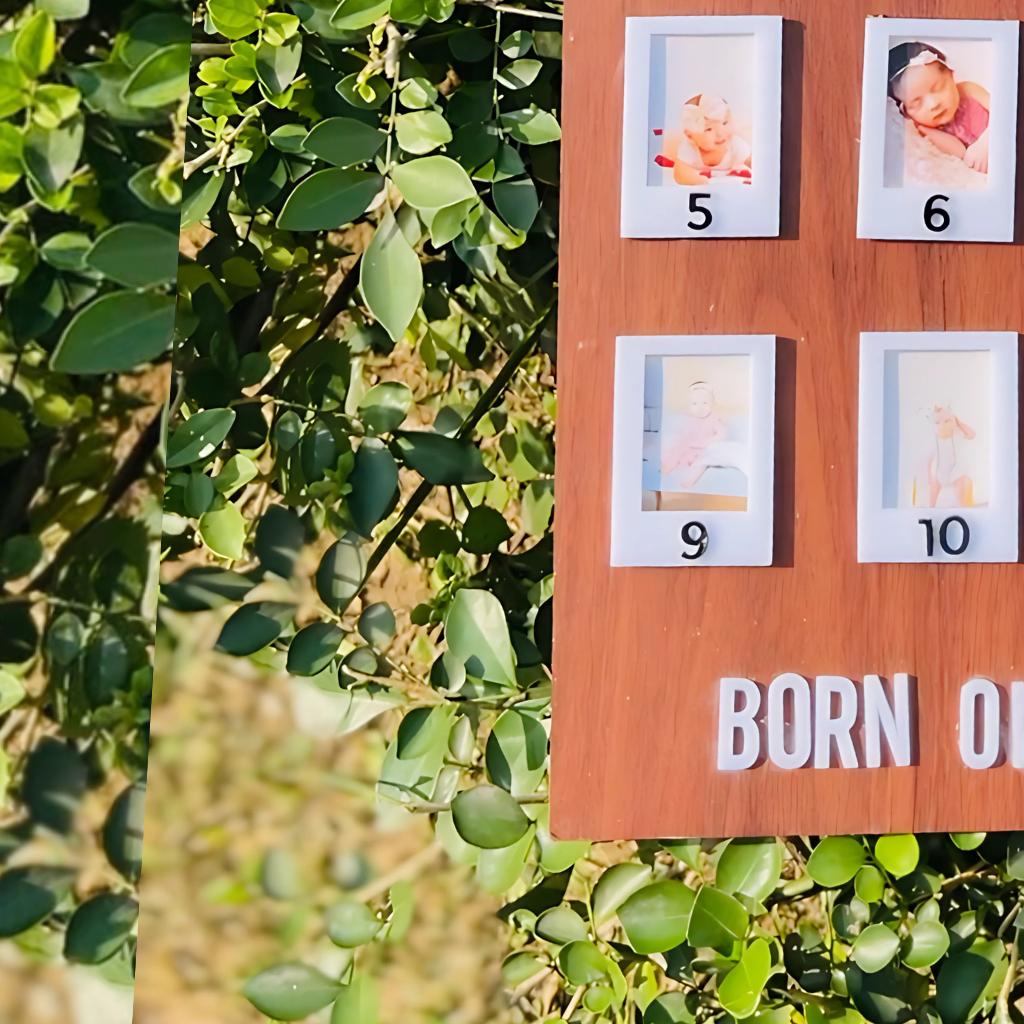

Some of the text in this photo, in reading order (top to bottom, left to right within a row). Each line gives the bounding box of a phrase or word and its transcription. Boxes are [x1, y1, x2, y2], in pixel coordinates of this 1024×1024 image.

[687, 192, 713, 230] 5
[923, 194, 951, 232] 6
[681, 520, 709, 559] 9
[918, 515, 971, 557] 10
[718, 672, 912, 771] BORN
